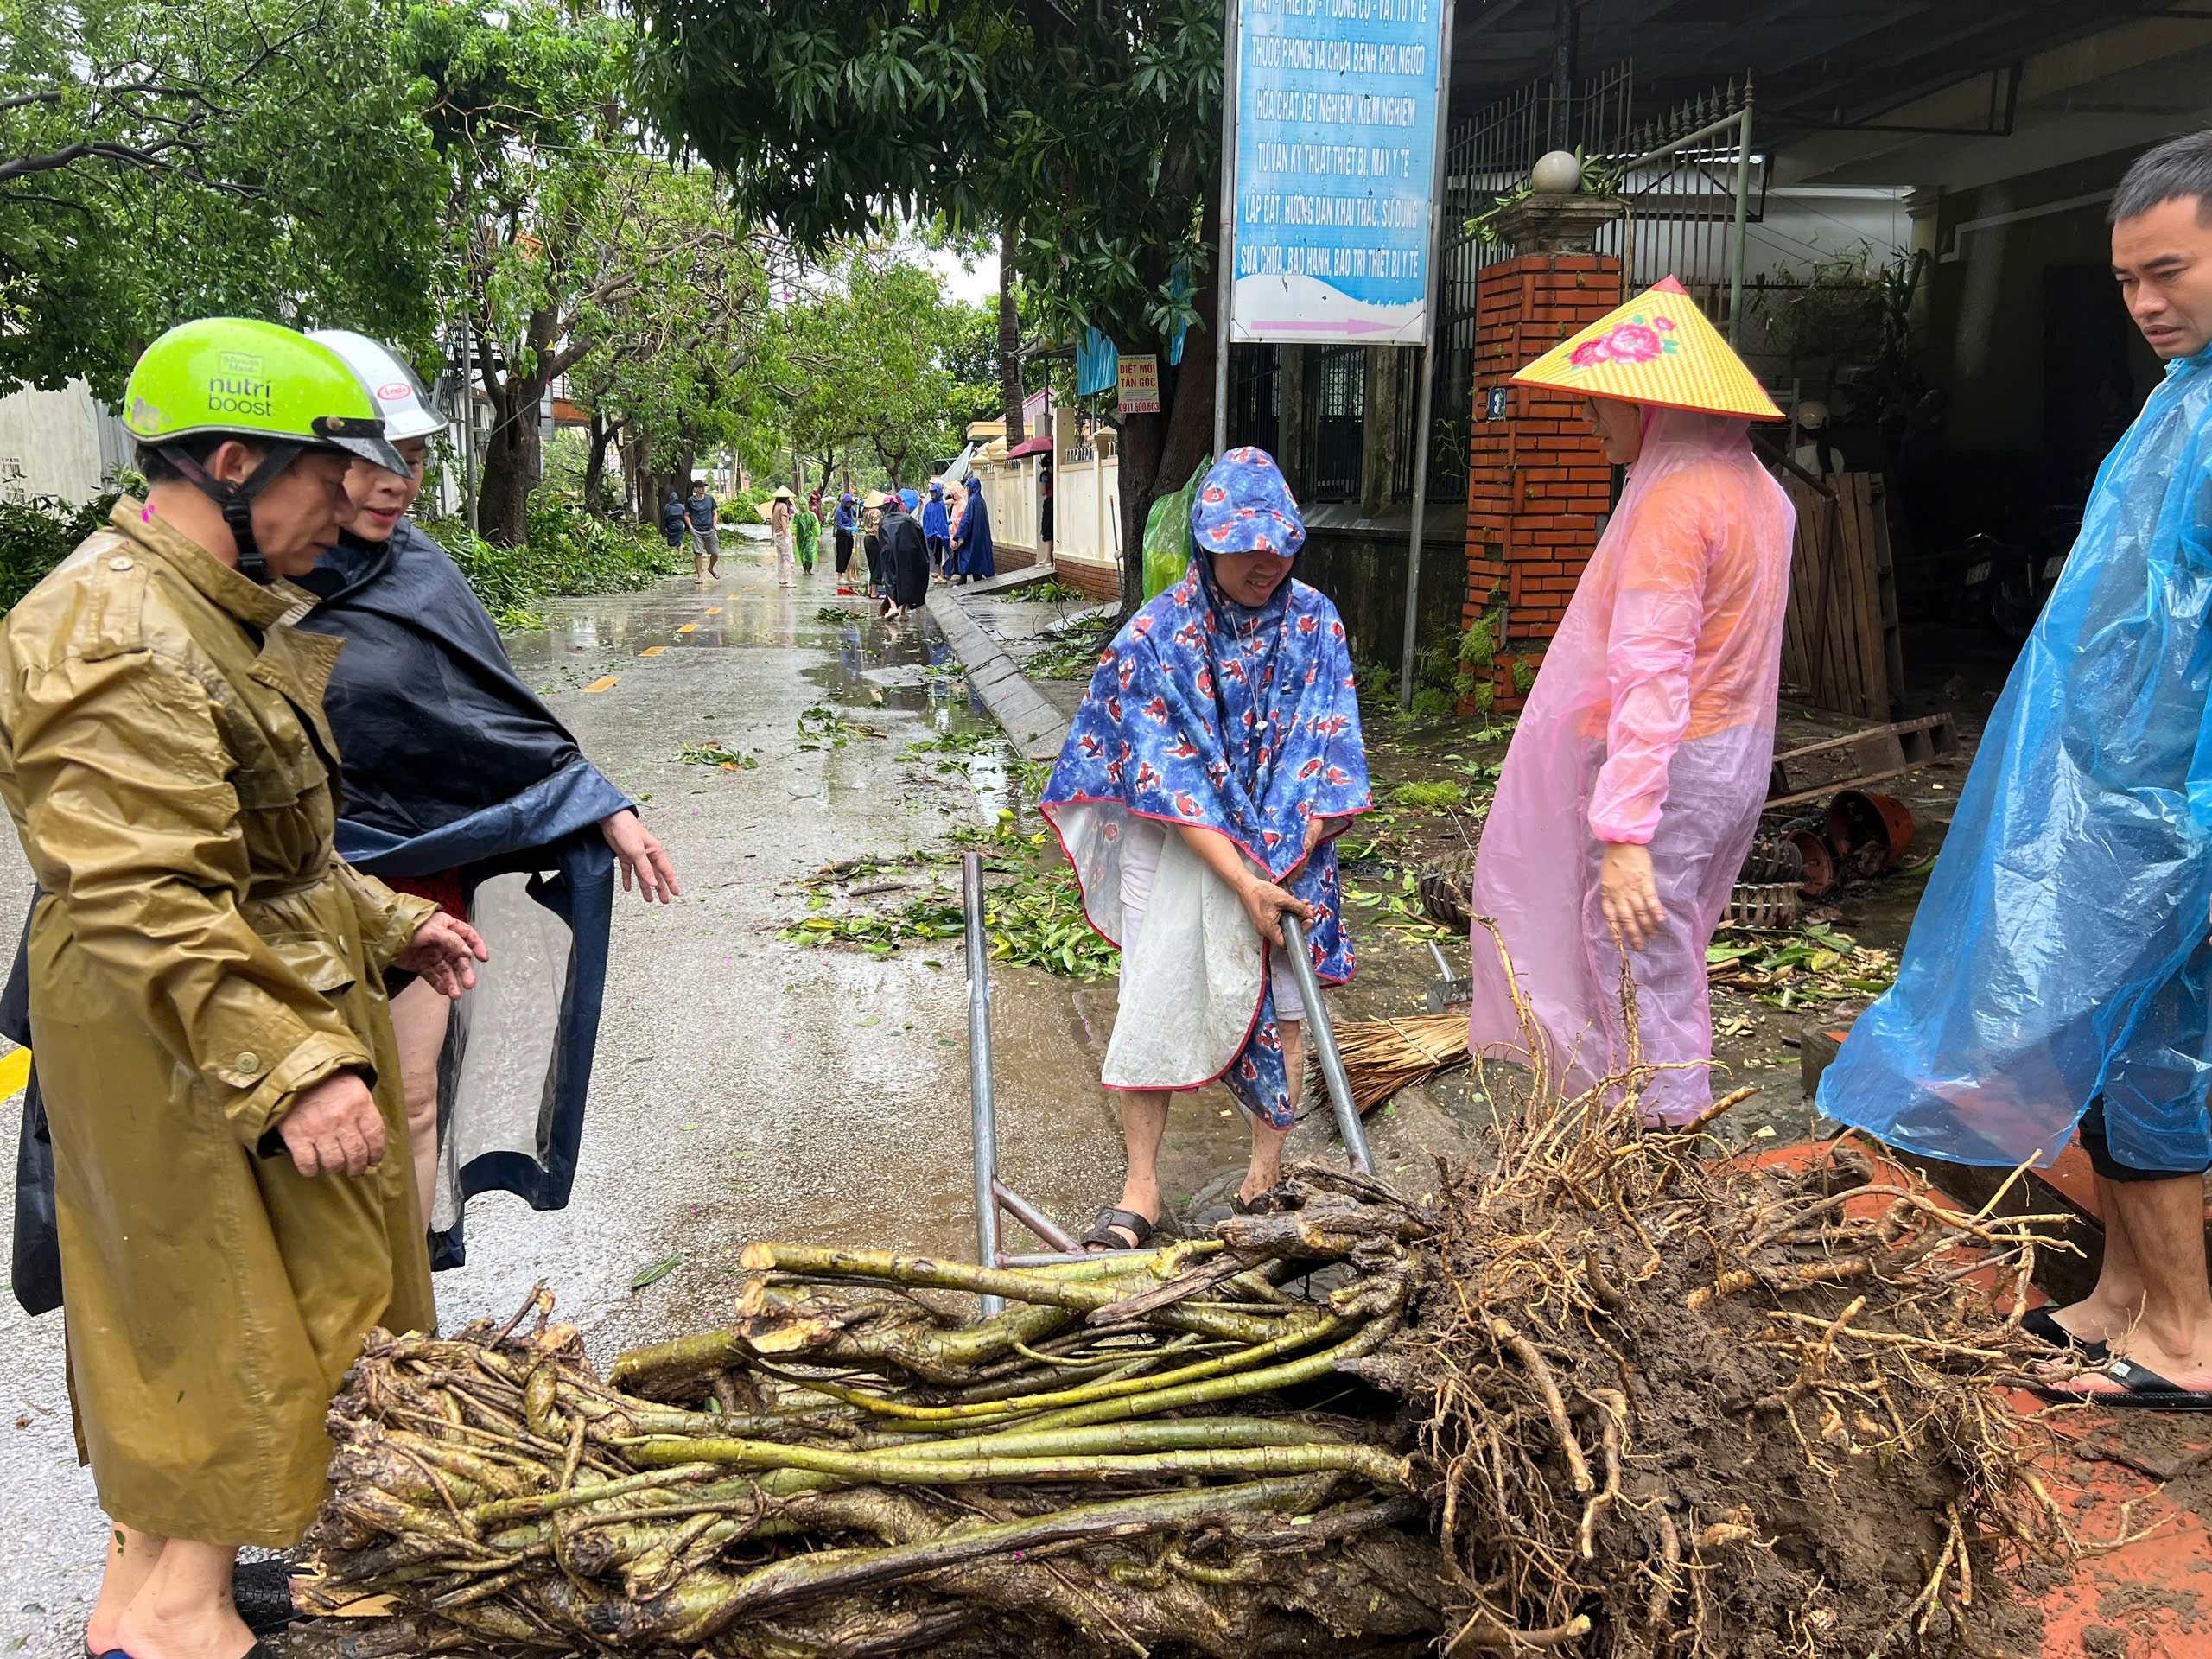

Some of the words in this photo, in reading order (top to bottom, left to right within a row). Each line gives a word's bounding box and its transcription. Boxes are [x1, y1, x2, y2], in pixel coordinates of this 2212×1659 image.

[1252, 25, 1281, 68] THUỐC
[1281, 30, 1313, 70] PHÒNG
[1314, 33, 1325, 70] VÀ
[1327, 33, 1351, 73] CHỮA
[1352, 35, 1377, 79] BỆNH
[1378, 43, 1397, 74] CHO
[1397, 37, 1425, 76] NGƯỜI
[1256, 83, 1274, 120] HÓA
[1276, 80, 1300, 121] CHẤT
[1300, 85, 1318, 122] XÉT
[1381, 91, 1416, 133] NGHIỆM
[1257, 139, 1270, 173] TƯ
[1270, 131, 1289, 173] VẤN
[1290, 137, 1302, 173] KỸ
[1304, 138, 1332, 181] THUẬT
[1332, 135, 1357, 176] THIẾT
[1371, 141, 1390, 177] MÁY
[1392, 149, 1399, 177] Y
[1400, 138, 1411, 178] TẾ
[1245, 183, 1262, 224] LẮP
[1284, 187, 1314, 226] HƯỚNG
[1315, 185, 1334, 226] DẪN
[1335, 197, 1355, 226] KHAI
[1382, 186, 1395, 228] SỬ
[1395, 199, 1418, 235] DỤNG
[1240, 232, 1258, 275] SỬA
[1287, 234, 1305, 275] BẢO
[1333, 235, 1351, 276] BẢO
[1352, 242, 1367, 277] TRÌ
[1368, 238, 1391, 277] THIẾT
[1391, 249, 1401, 284] BỊ
[1402, 250, 1408, 278] Y
[1409, 239, 1420, 279] TẾ
[1120, 363, 1137, 376] DIỆT
[1121, 377, 1137, 389] TẬN
[1139, 375, 1155, 387] GỐC
[209, 393, 271, 416] boost
